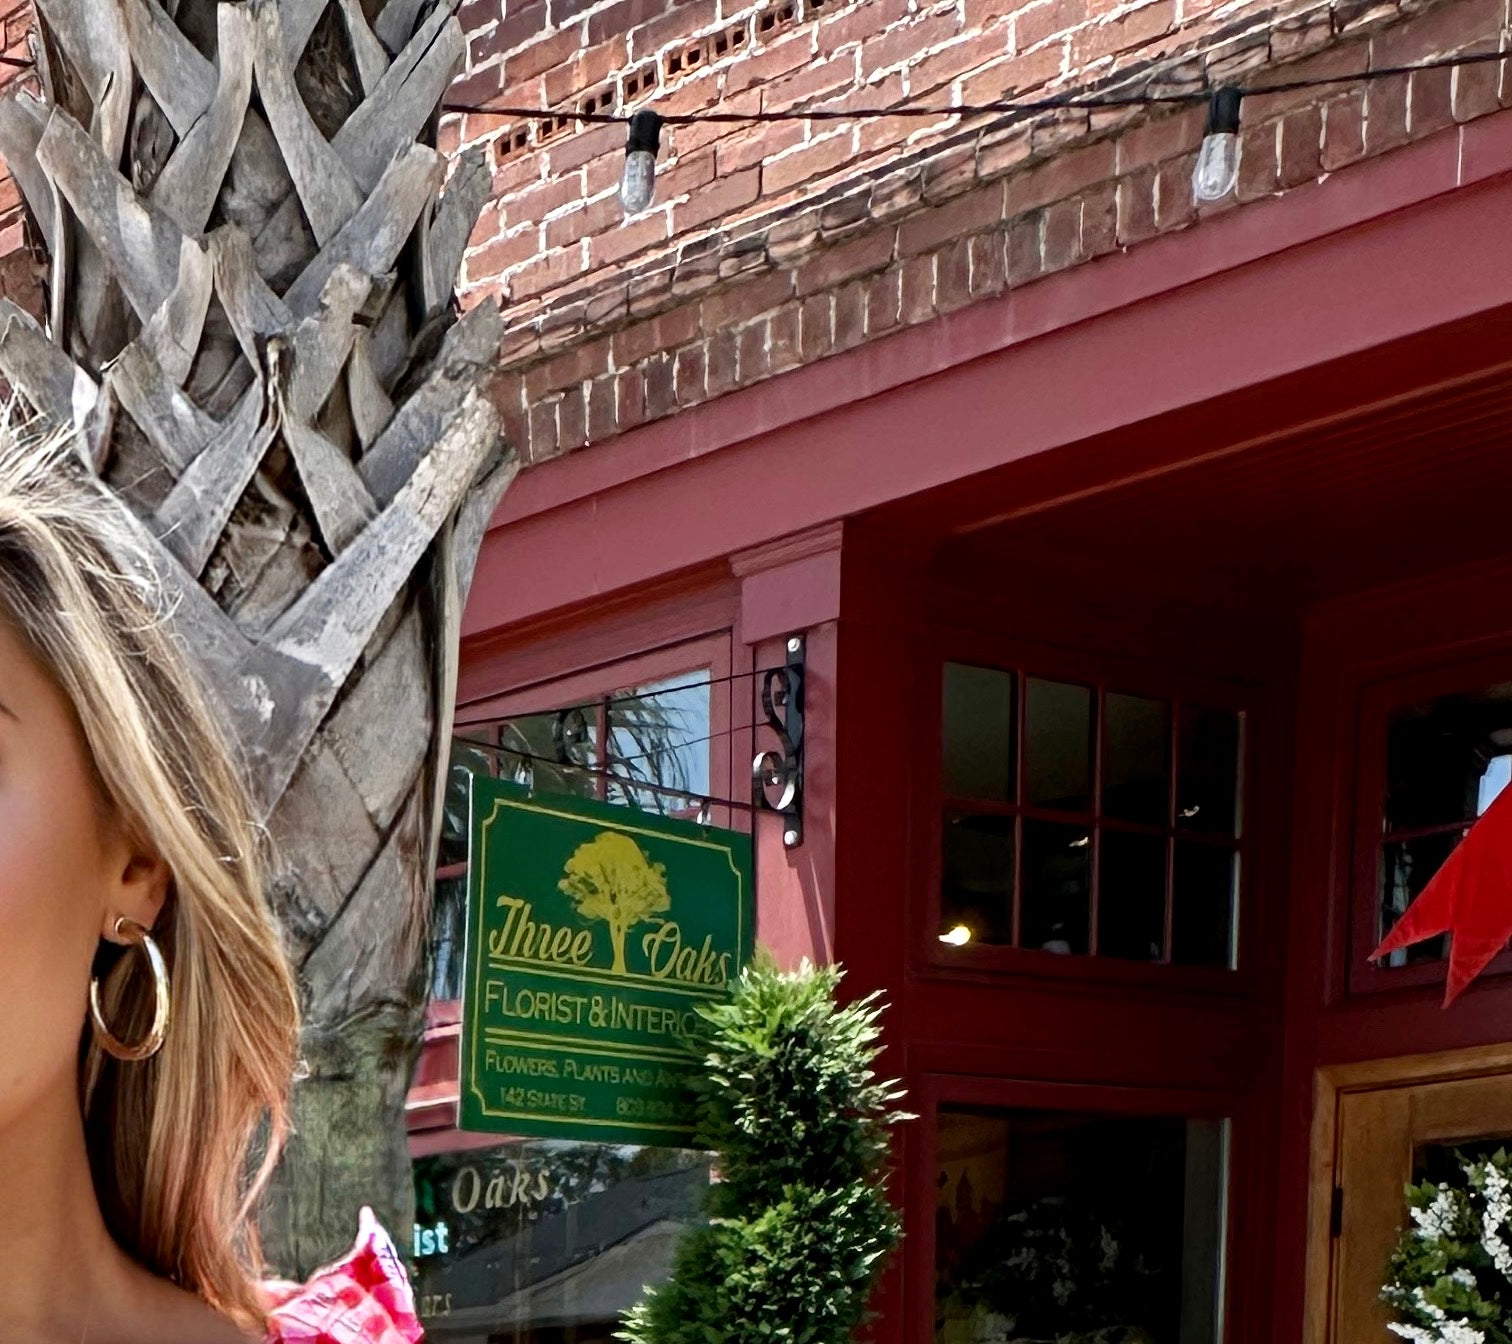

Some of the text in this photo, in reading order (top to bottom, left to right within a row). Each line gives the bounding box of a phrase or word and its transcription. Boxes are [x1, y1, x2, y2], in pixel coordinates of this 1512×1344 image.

[489, 895, 732, 984] Three Oaks
[485, 979, 698, 1037] FLORIST & INTERIO
[452, 1159, 551, 1214] Oaks
